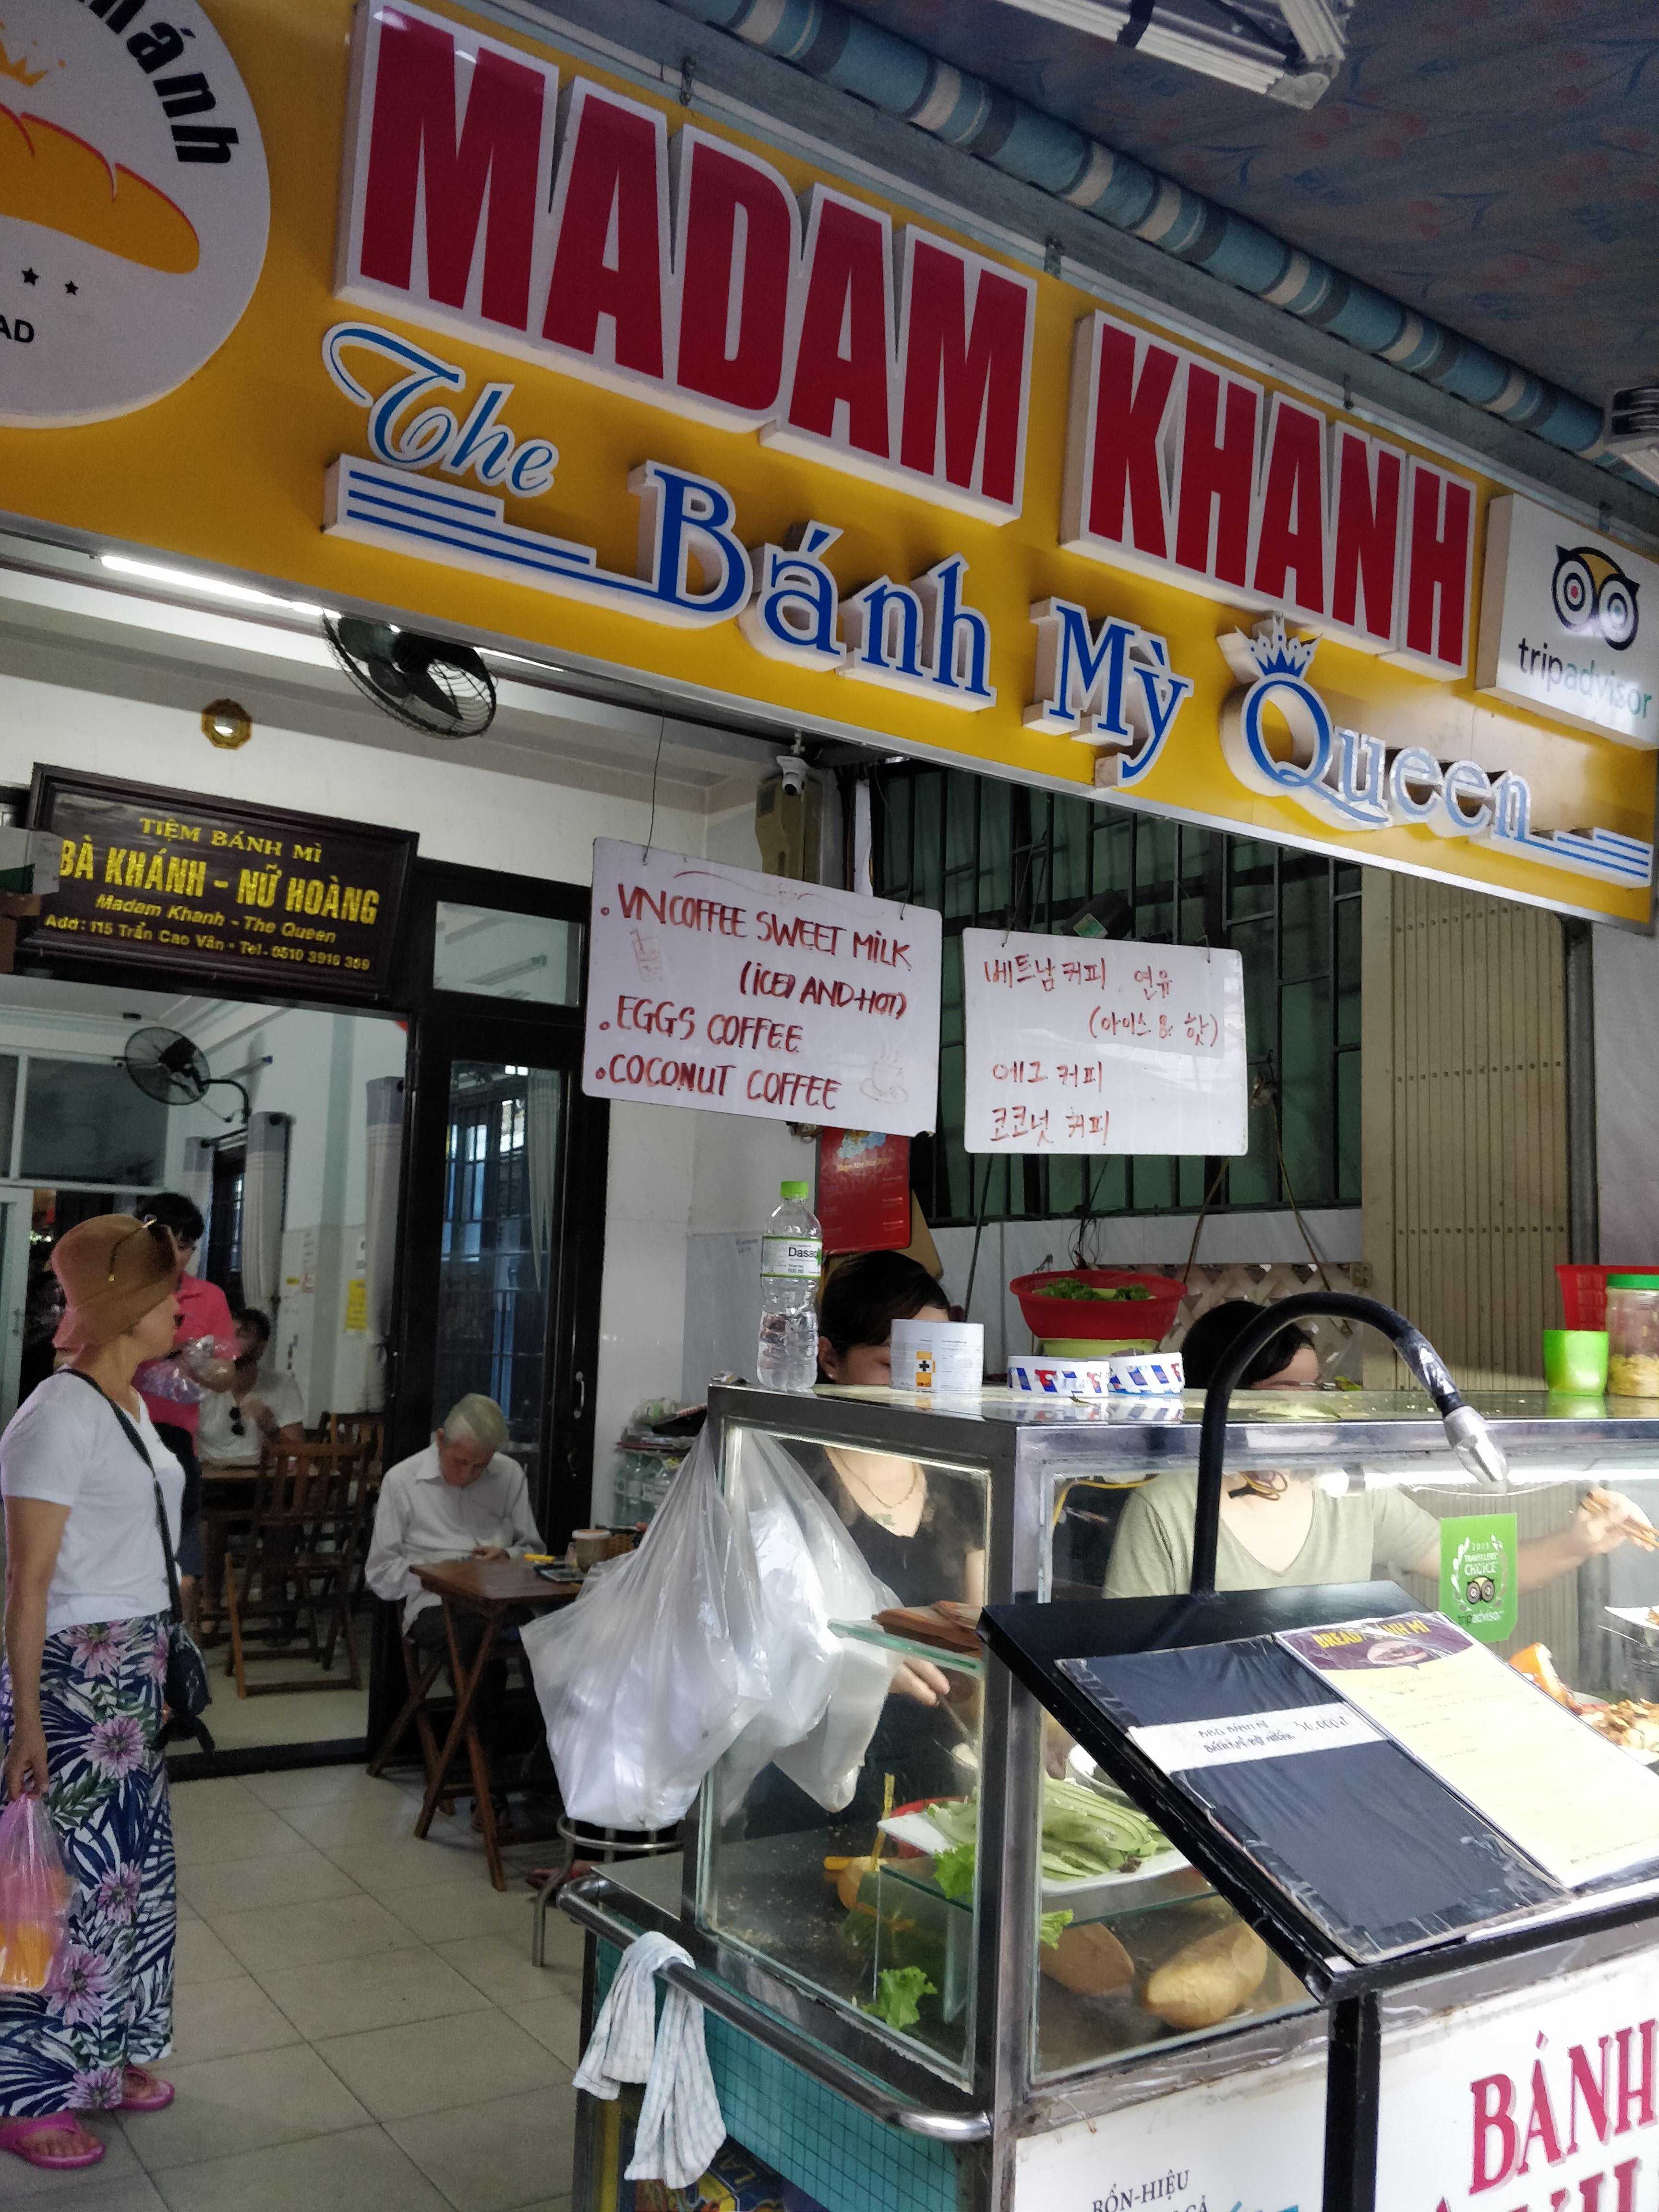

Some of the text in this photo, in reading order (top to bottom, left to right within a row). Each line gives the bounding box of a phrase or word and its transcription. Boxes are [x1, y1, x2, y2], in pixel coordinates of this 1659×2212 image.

[360, 6, 1471, 666] MADAM KHANH
[330, 328, 1531, 842] The Bánh Mỳ Queen
[1518, 638, 1652, 718] tripadvisor
[140, 817, 322, 864] TIỆM BÁNH MÌ
[60, 834, 94, 880] BÀ
[105, 847, 207, 898] KHÁNH
[236, 863, 283, 909] NỮ
[285, 875, 380, 925] HOÀNG
[90, 919, 113, 936] 115
[158, 929, 190, 946] Cao
[195, 934, 225, 951] Vân
[95, 893, 162, 917] Madam
[166, 904, 225, 927] Khanh
[243, 915, 276, 934] The
[281, 922, 337, 944] Queen
[755, 910, 847, 956] SWEET
[1134, 965, 1173, 1000] 연유
[616, 996, 804, 1054] EGGS COFFEE
[609, 1054, 842, 1111] COCONUT COFFEE
[992, 1061, 1102, 1093] 에그 커피
[990, 1105, 1109, 1146] 코코넛 커피
[1468, 2018, 1657, 2197] BÁNH
